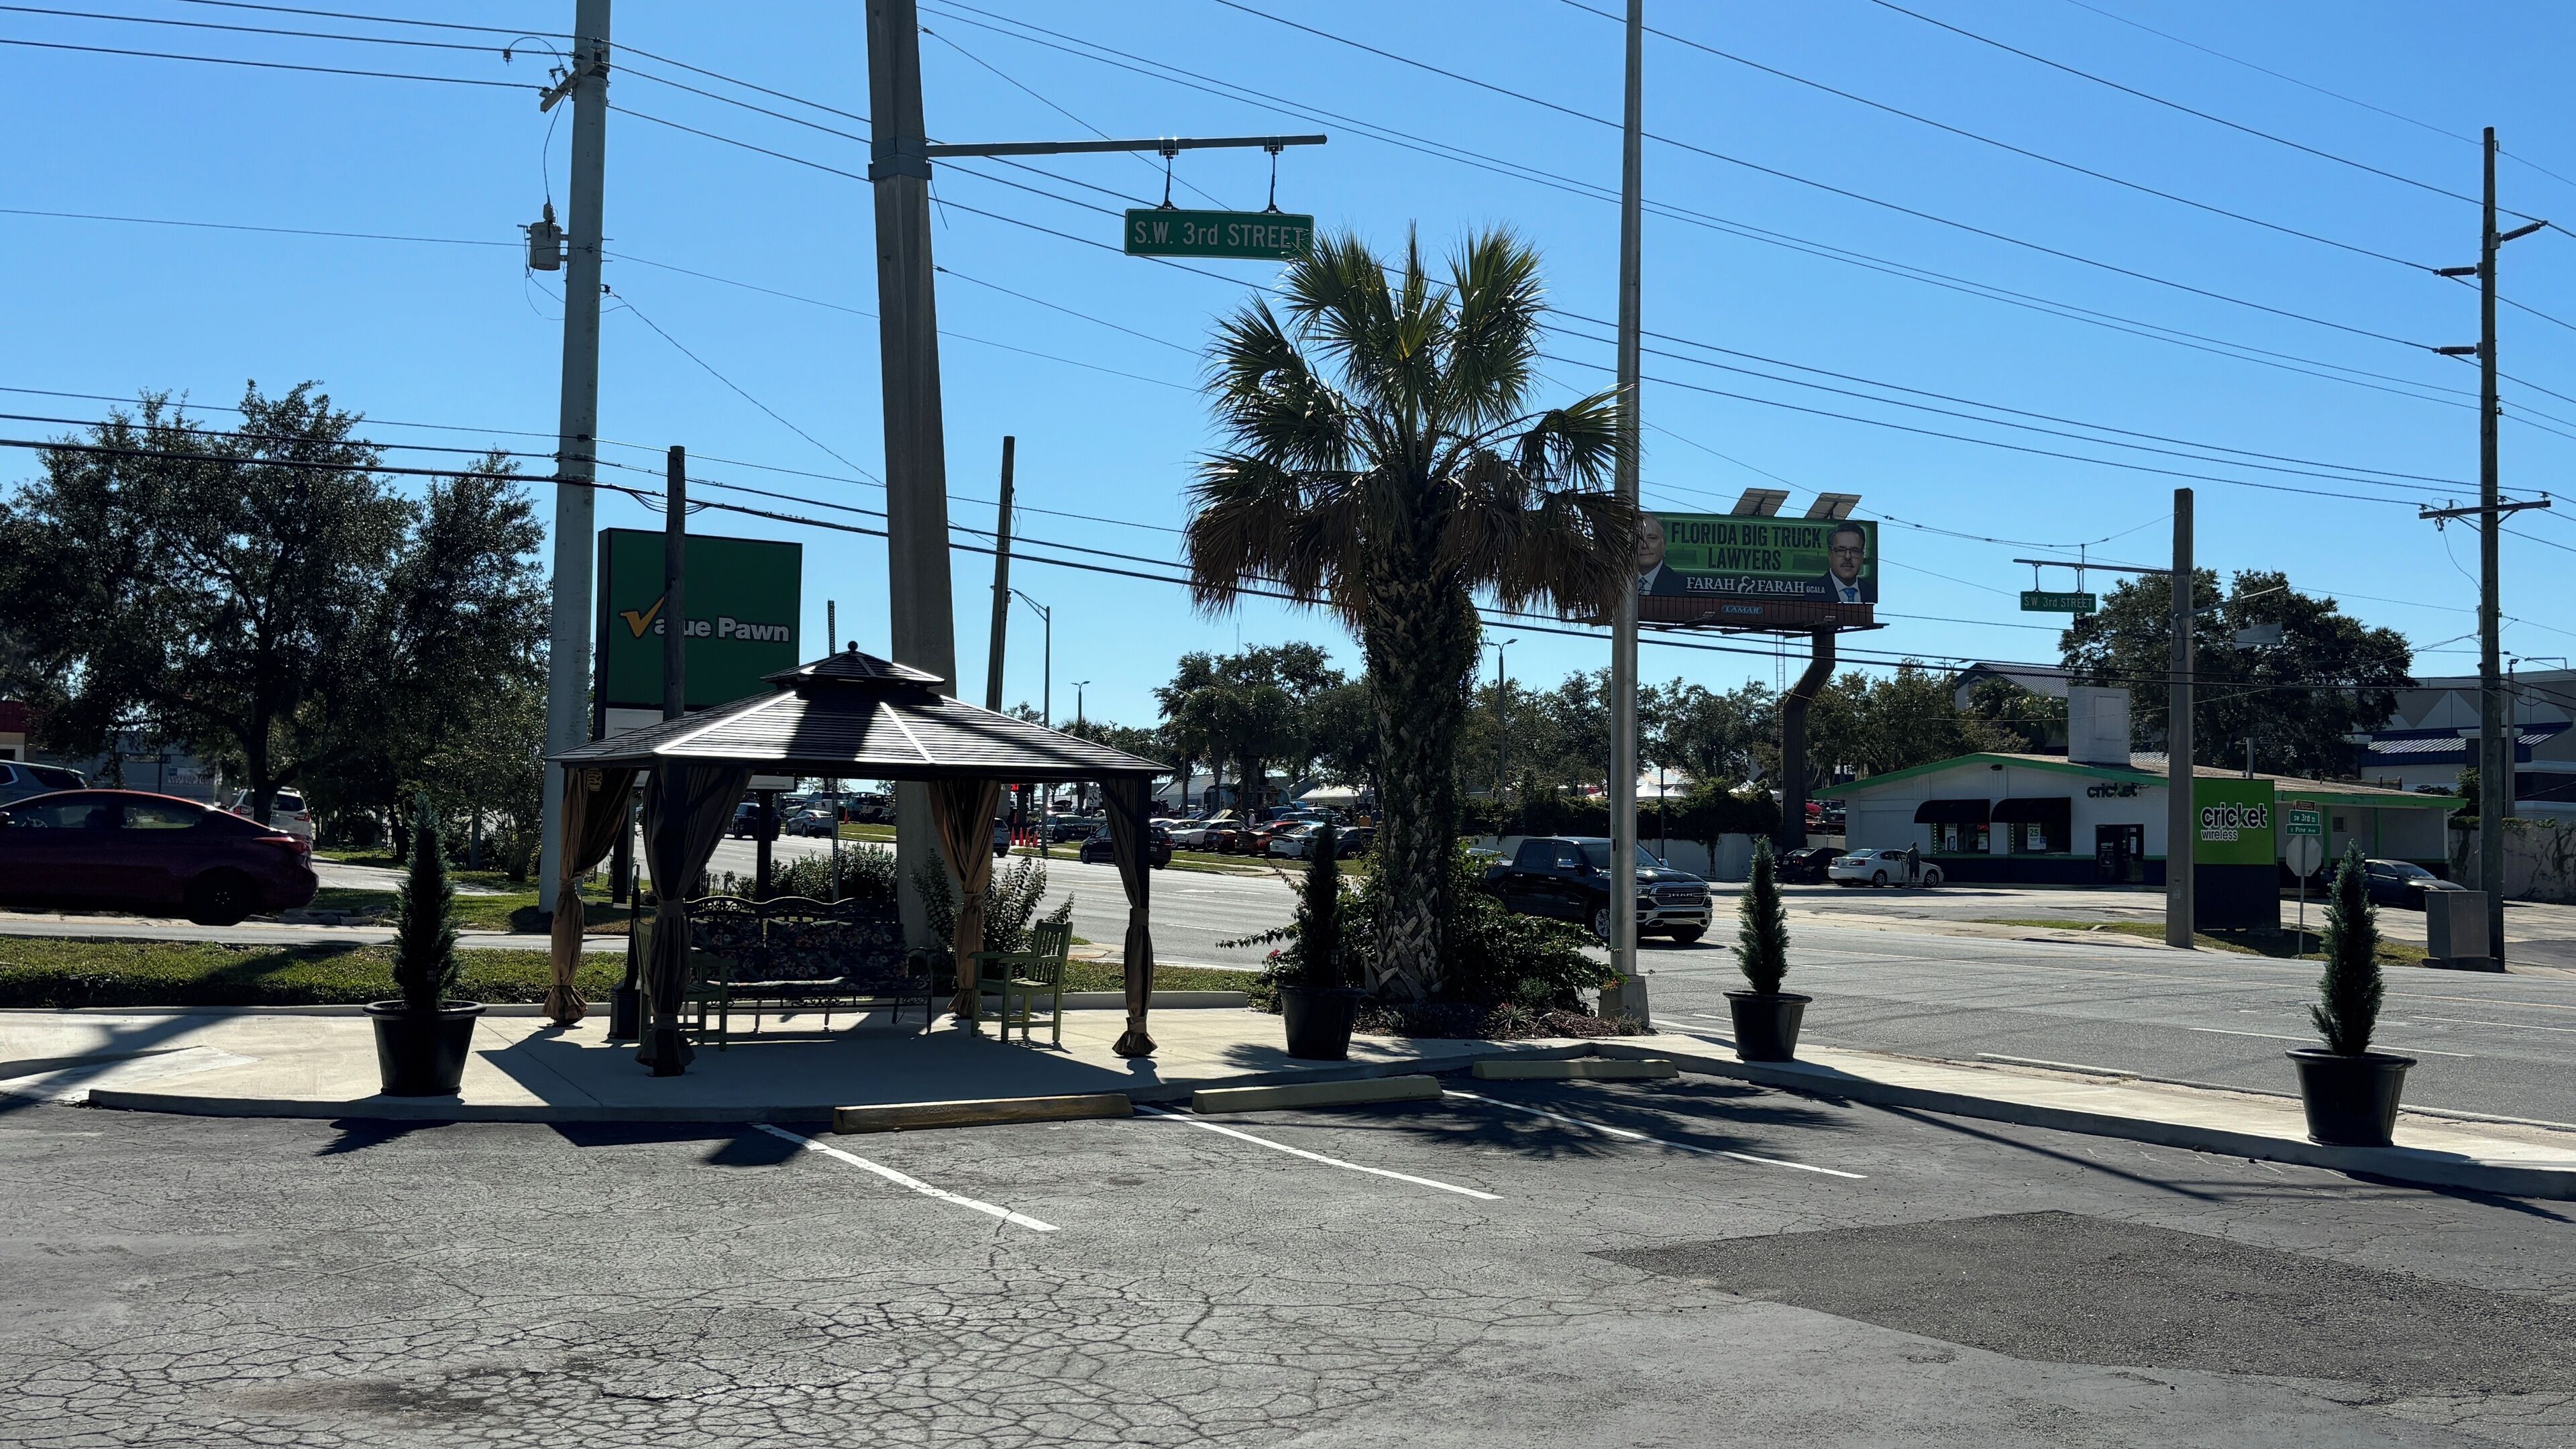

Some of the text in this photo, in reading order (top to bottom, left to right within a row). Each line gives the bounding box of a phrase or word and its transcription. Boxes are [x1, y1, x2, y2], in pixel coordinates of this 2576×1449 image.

[1134, 221, 1304, 249] S.W. 3rd STREET
[1671, 522, 1822, 549] FLORIDA BIG TRUCK
[1709, 549, 1782, 570] LAWYERS
[1686, 576, 1825, 594] FARAH & FARAH OCALA
[2043, 597, 2057, 607] 3rd
[2061, 598, 2092, 608] STREET
[621, 596, 789, 642] Vaue Pawn
[2087, 782, 2138, 798] cricket
[2201, 802, 2267, 828] cricket
[2301, 813, 2310, 822] 3rd
[2201, 828, 2238, 841] wireless
